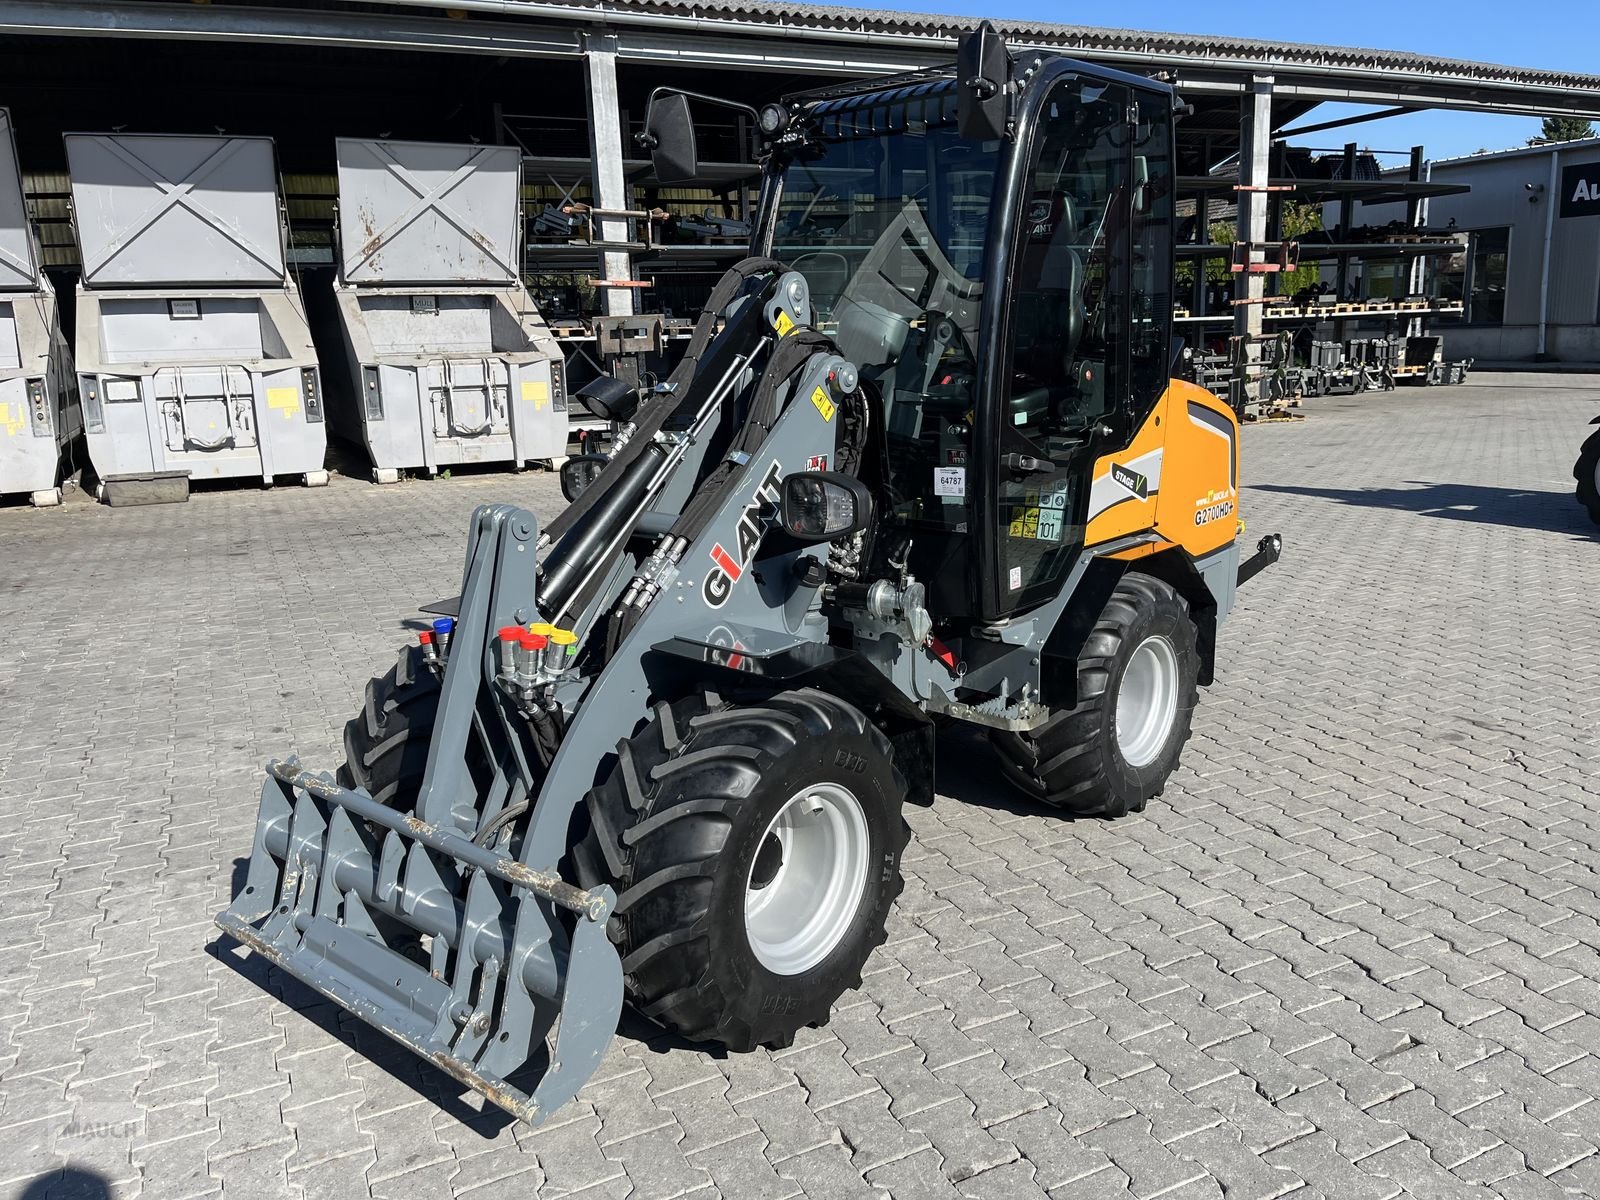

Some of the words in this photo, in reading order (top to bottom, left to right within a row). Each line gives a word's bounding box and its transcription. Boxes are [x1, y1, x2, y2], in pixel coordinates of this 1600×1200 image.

[940, 476, 961, 485] 64787
[1114, 470, 1135, 489] STAGE
[1136, 474, 1145, 492] V
[1194, 500, 1234, 526] G2700HD+
[1040, 522, 1055, 539] 101
